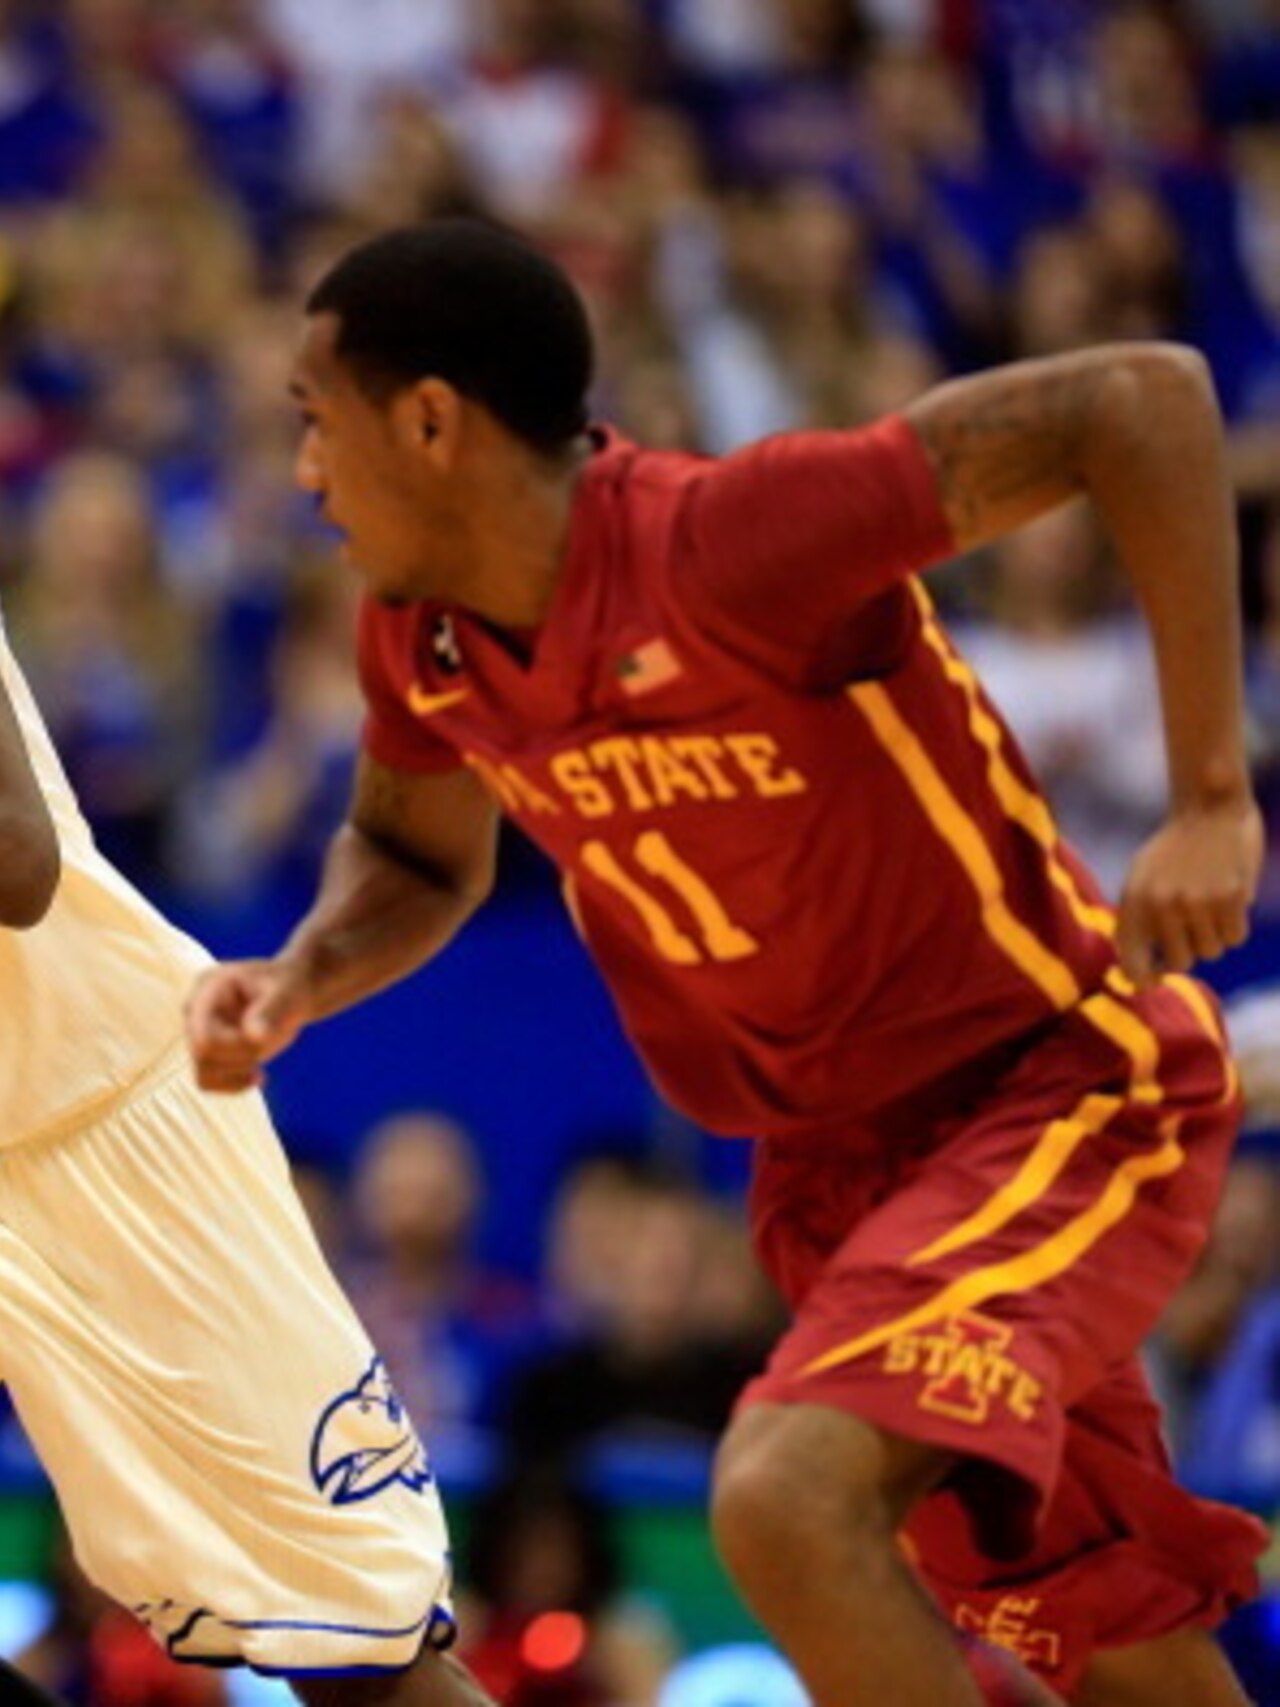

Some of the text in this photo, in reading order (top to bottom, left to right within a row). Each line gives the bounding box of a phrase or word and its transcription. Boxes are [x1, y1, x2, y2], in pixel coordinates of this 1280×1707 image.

[550, 732, 807, 819] STATE
[581, 830, 759, 965] 11
[883, 1335, 1041, 1421] STATE
